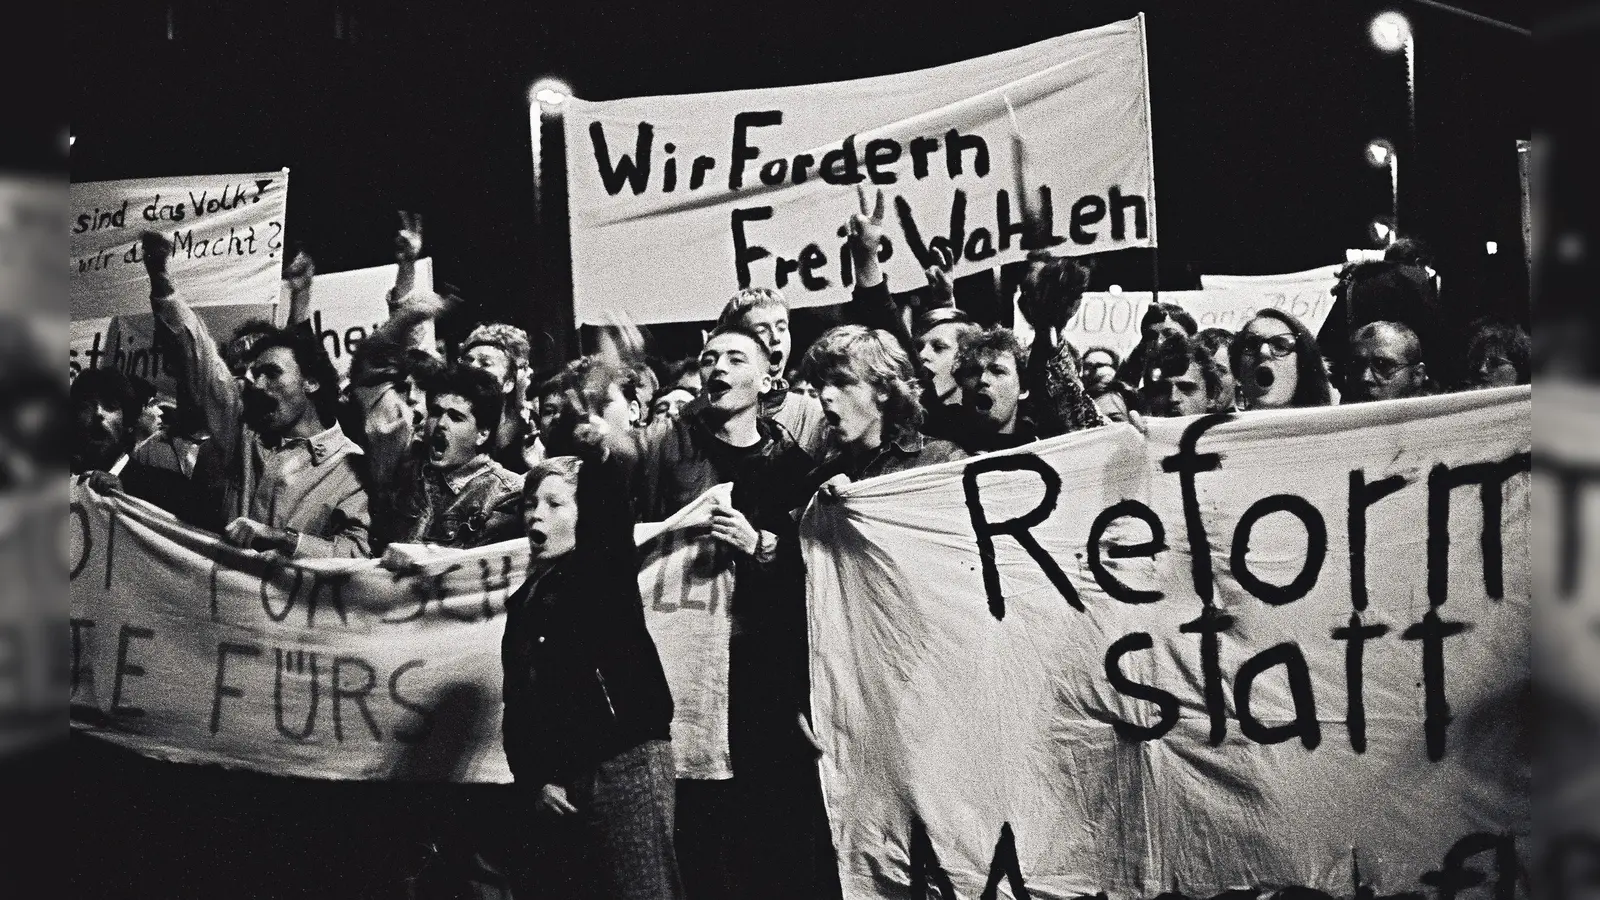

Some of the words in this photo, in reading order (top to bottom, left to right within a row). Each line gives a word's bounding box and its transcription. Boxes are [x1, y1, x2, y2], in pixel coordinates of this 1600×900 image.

[590, 122, 715, 195] Wir
[728, 111, 991, 190] Fordern
[73, 201, 127, 233] sind
[143, 195, 185, 222] das
[189, 179, 273, 217] Volk!
[78, 249, 113, 274] wir
[208, 640, 434, 744] FÜRS
[1103, 606, 1474, 763] statt
